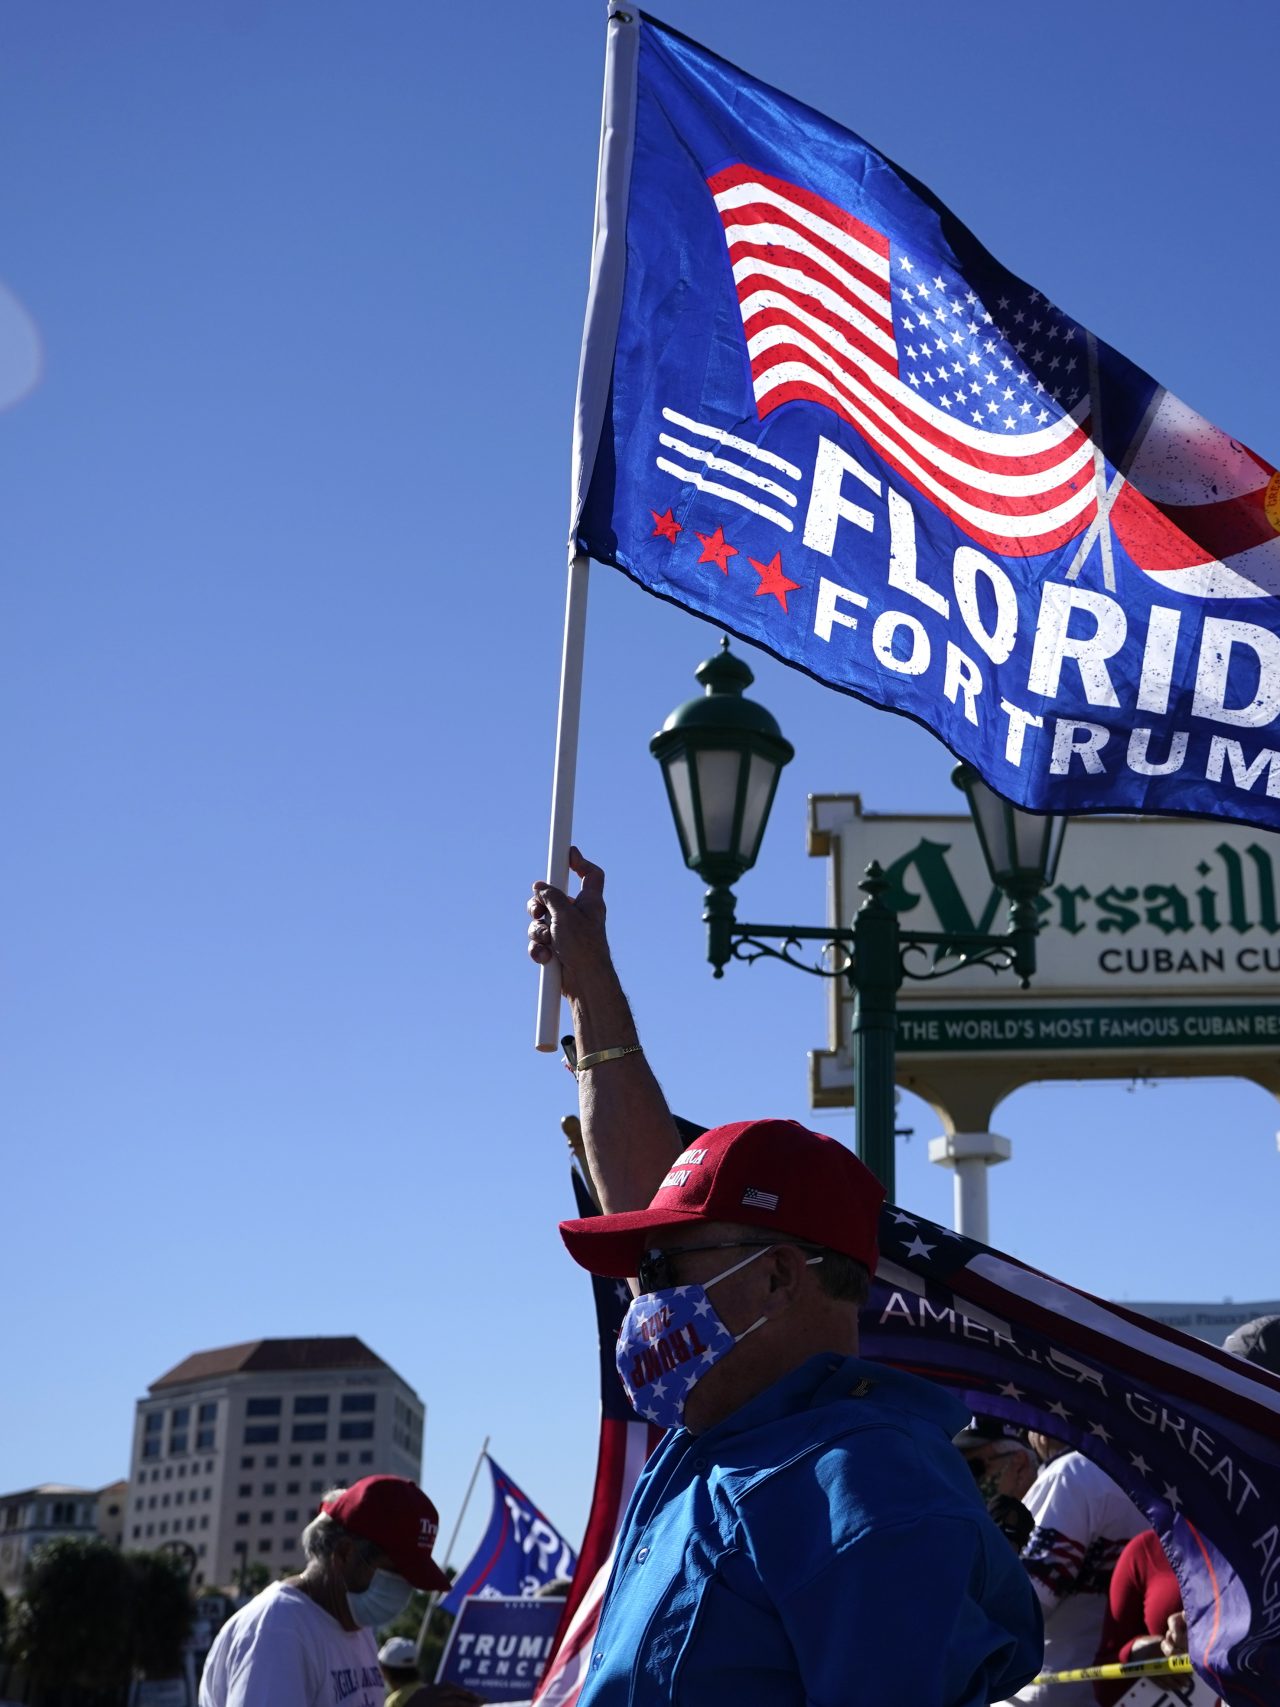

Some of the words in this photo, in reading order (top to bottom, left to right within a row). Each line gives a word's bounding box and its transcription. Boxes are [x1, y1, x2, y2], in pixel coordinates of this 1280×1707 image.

[813, 577, 983, 727] FOR
[1099, 948, 1225, 974] CUBAN
[901, 1020, 939, 1041] THE
[945, 1020, 1034, 1040] WORLD'S
[1039, 1018, 1094, 1038] MOST
[1100, 1017, 1180, 1037] FAMOUS
[1184, 1015, 1250, 1036] CUBAN
[1126, 1392, 1260, 1515] GREAT
